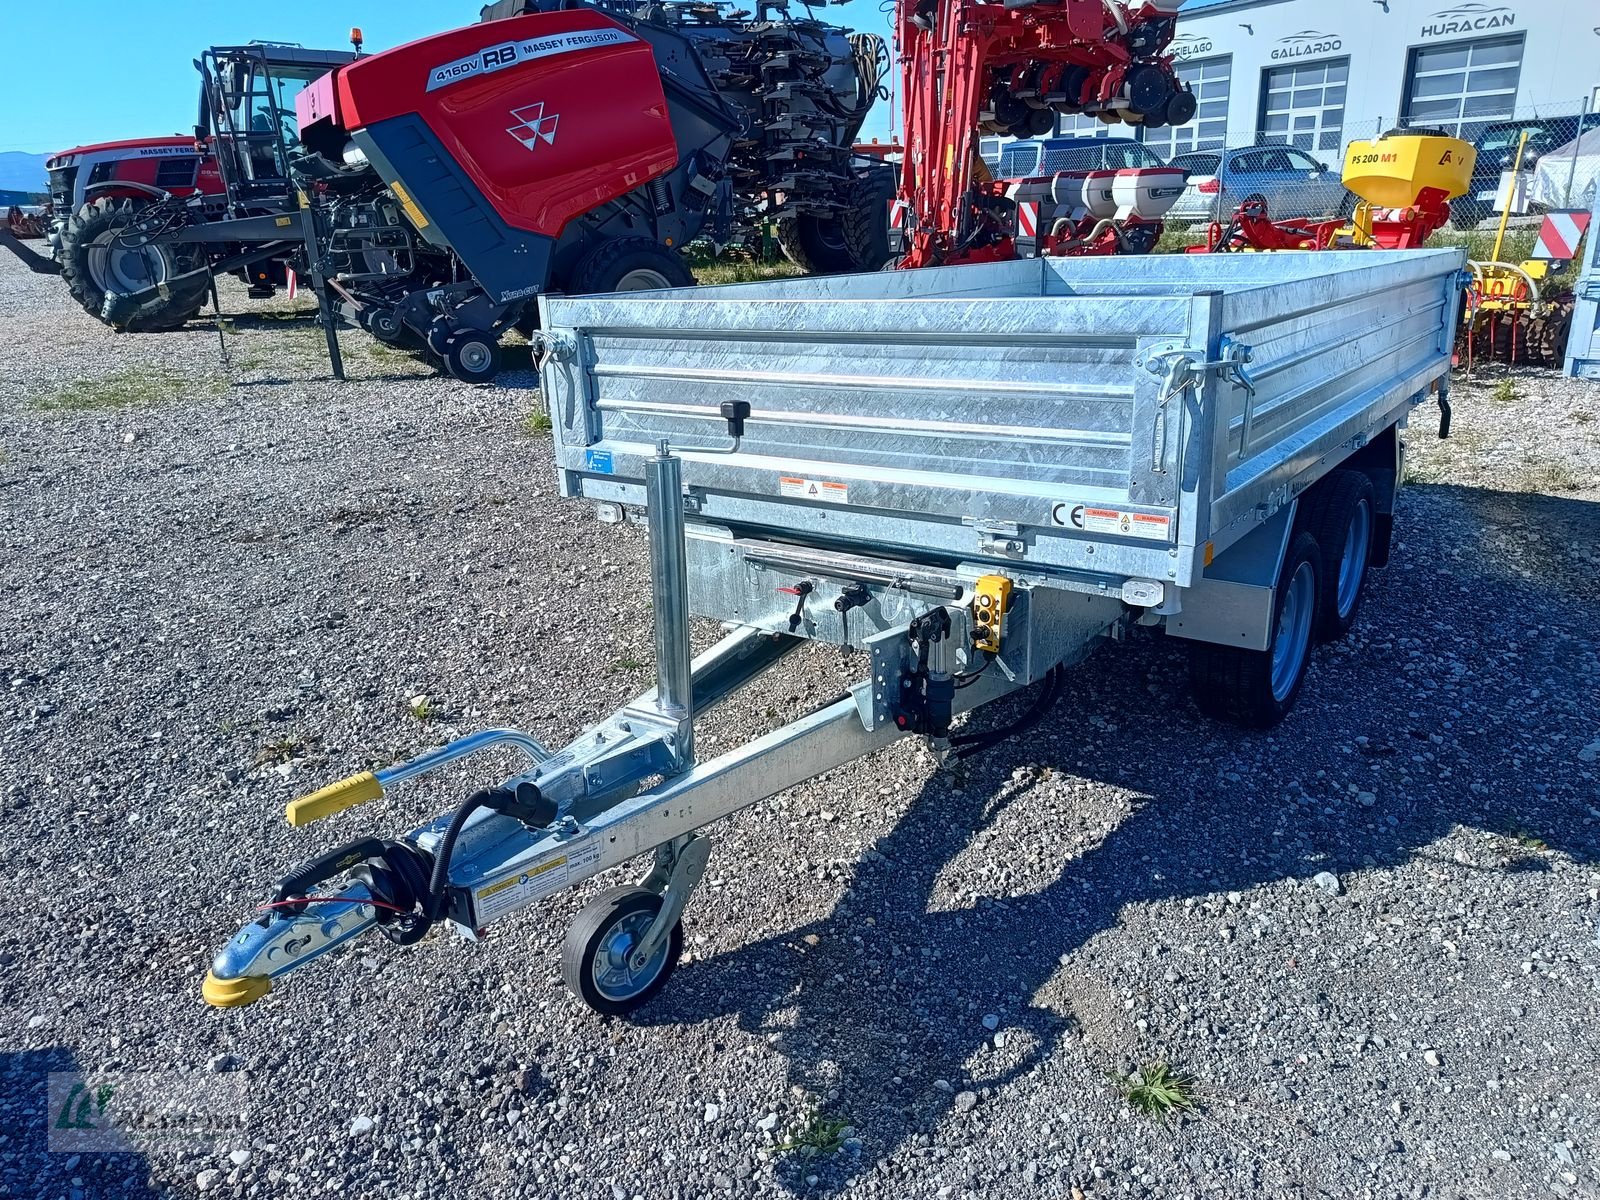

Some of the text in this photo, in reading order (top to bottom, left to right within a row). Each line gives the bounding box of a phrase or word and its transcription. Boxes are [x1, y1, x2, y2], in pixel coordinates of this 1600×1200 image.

[1421, 13, 1515, 37] HURACAN
[436, 33, 618, 81] 4160V RB MASSEY FERGUSON
[1271, 39, 1342, 60] GALLARDO
[140, 147, 173, 156] MASSEY
[1352, 153, 1398, 164] PS 200 M1
[1052, 503, 1084, 528] CE
[583, 855, 593, 864] 100
